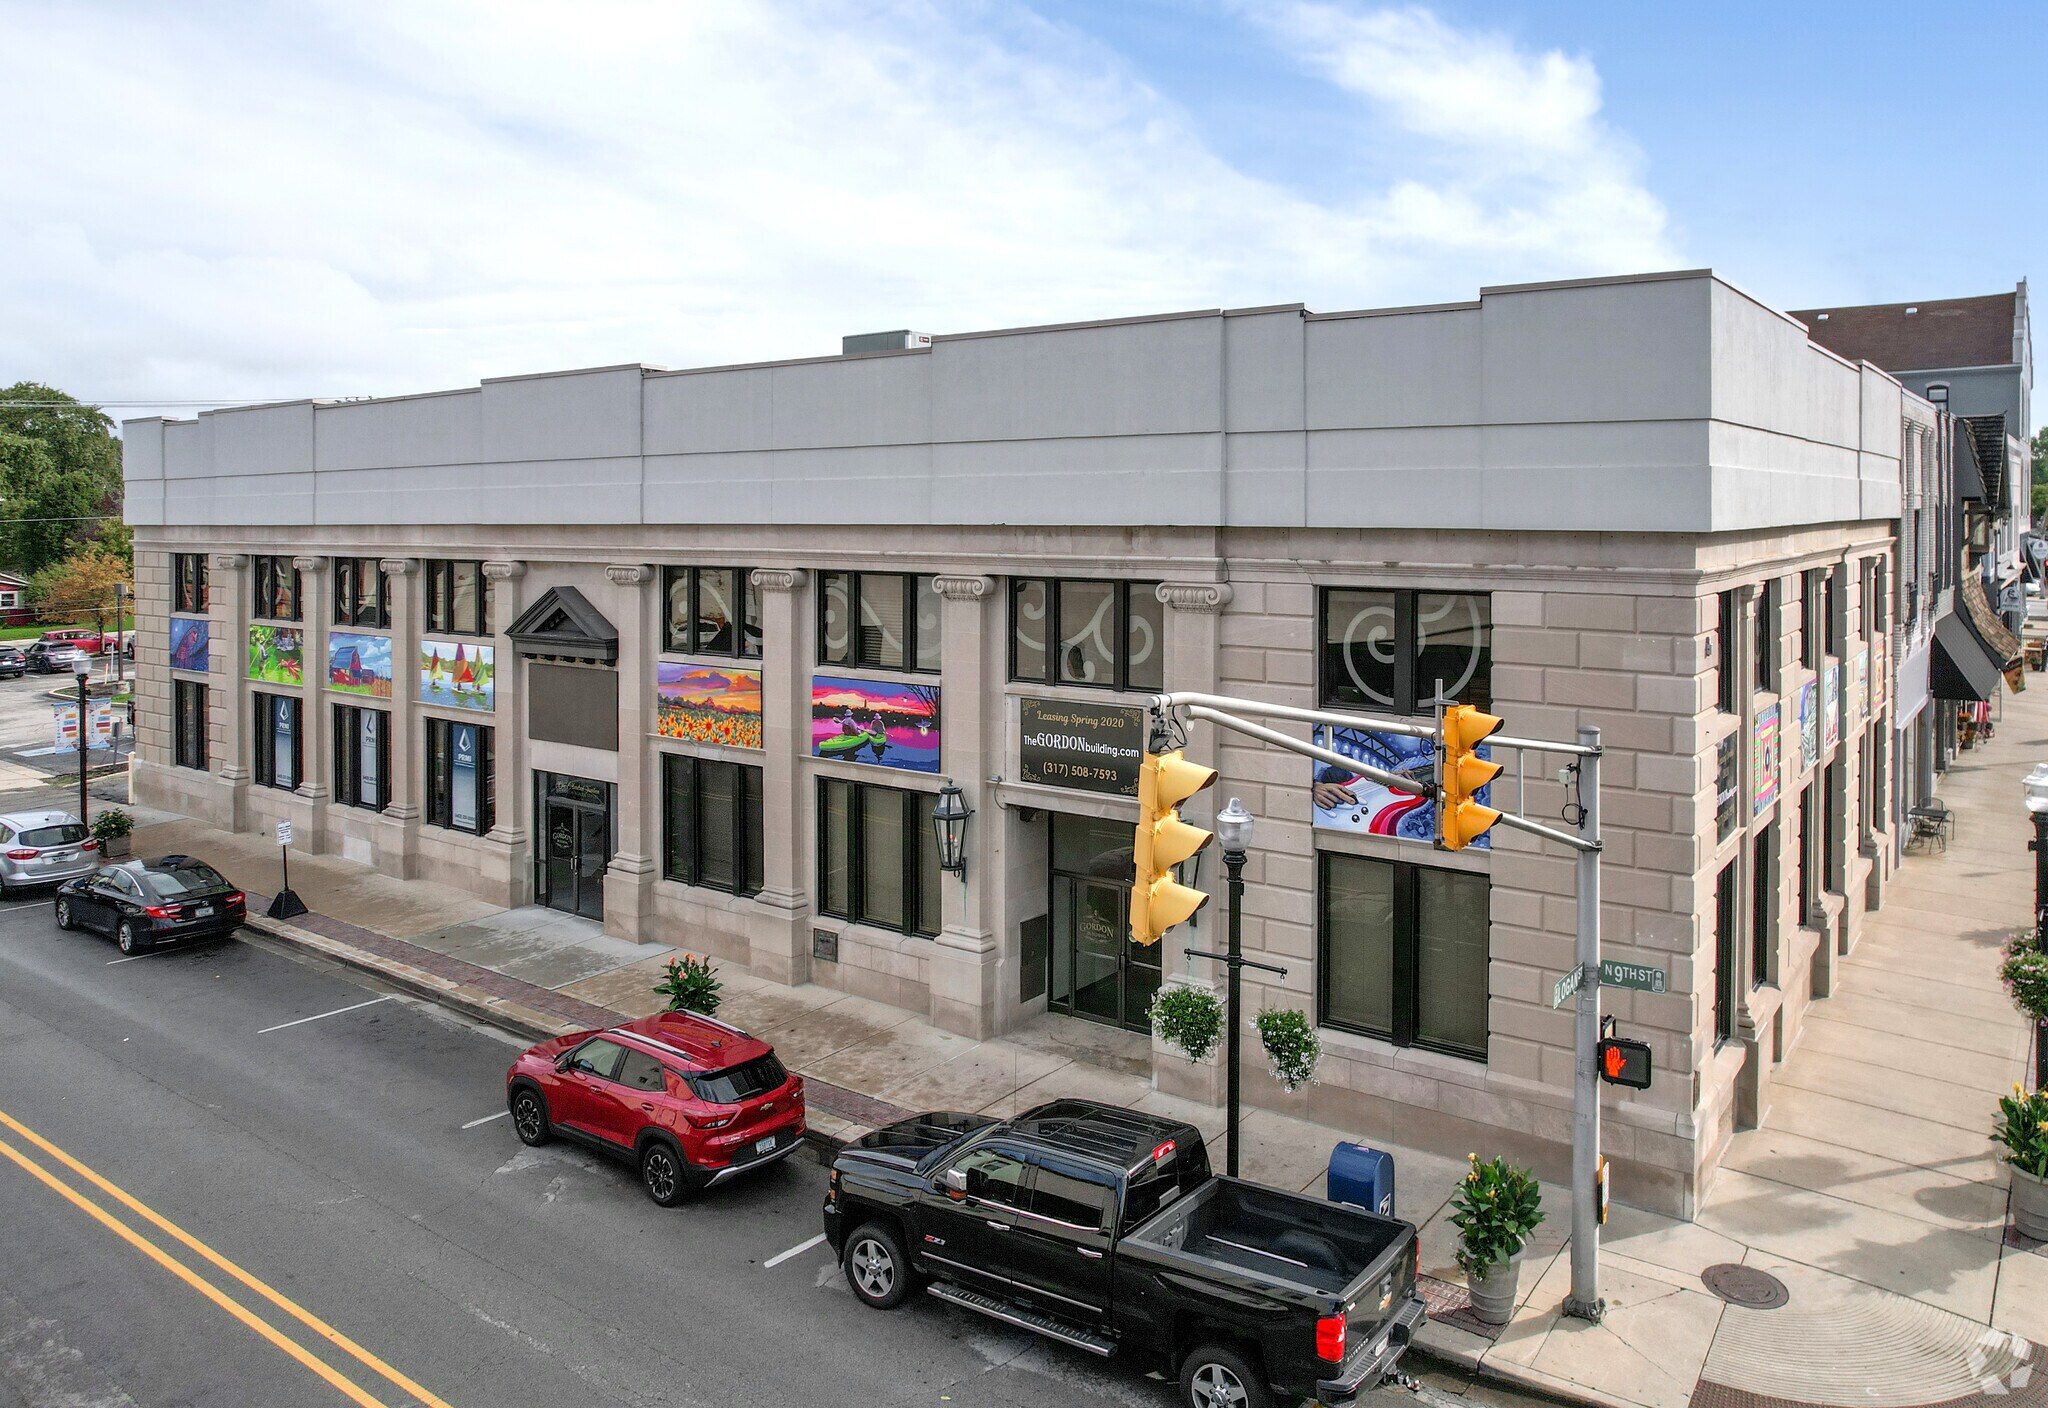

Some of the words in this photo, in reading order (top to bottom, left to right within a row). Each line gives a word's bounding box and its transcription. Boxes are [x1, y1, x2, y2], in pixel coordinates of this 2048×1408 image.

[1036, 710, 1070, 725] Leasing
[1070, 713, 1100, 729] Spring
[1100, 716, 1125, 728] 2020
[1023, 732, 1140, 758] TheGORDONbuilding.com
[1043, 761, 1069, 777] (317)
[1071, 765, 1118, 781] 508-7593
[1079, 922, 1114, 938] GORDON
[1605, 964, 1613, 976] N
[1614, 965, 1637, 983] 9TH
[1639, 969, 1653, 982] ST
[1557, 972, 1578, 1004] LOGAN
